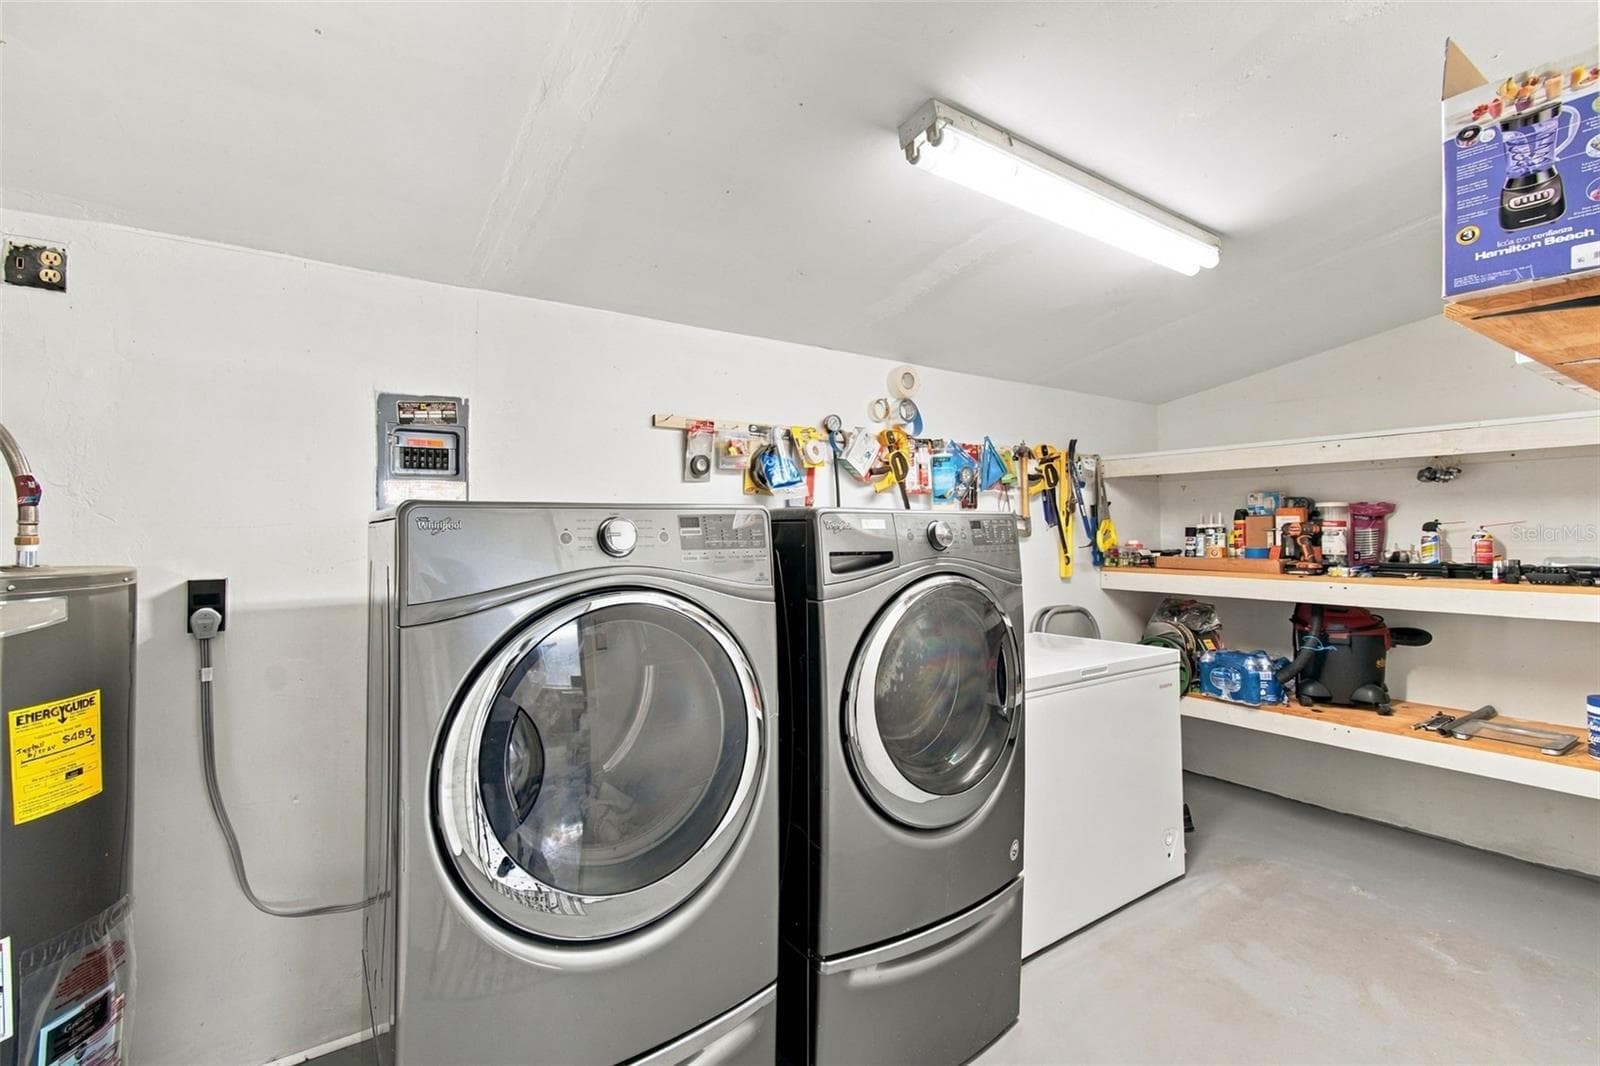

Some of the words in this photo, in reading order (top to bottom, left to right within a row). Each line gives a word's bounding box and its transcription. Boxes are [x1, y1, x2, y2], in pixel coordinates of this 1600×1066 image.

[1532, 226, 1573, 240] confianza
[1474, 241, 1542, 261] Hamilton
[1544, 228, 1595, 246] Beach
[416, 517, 462, 532] Whirlpool
